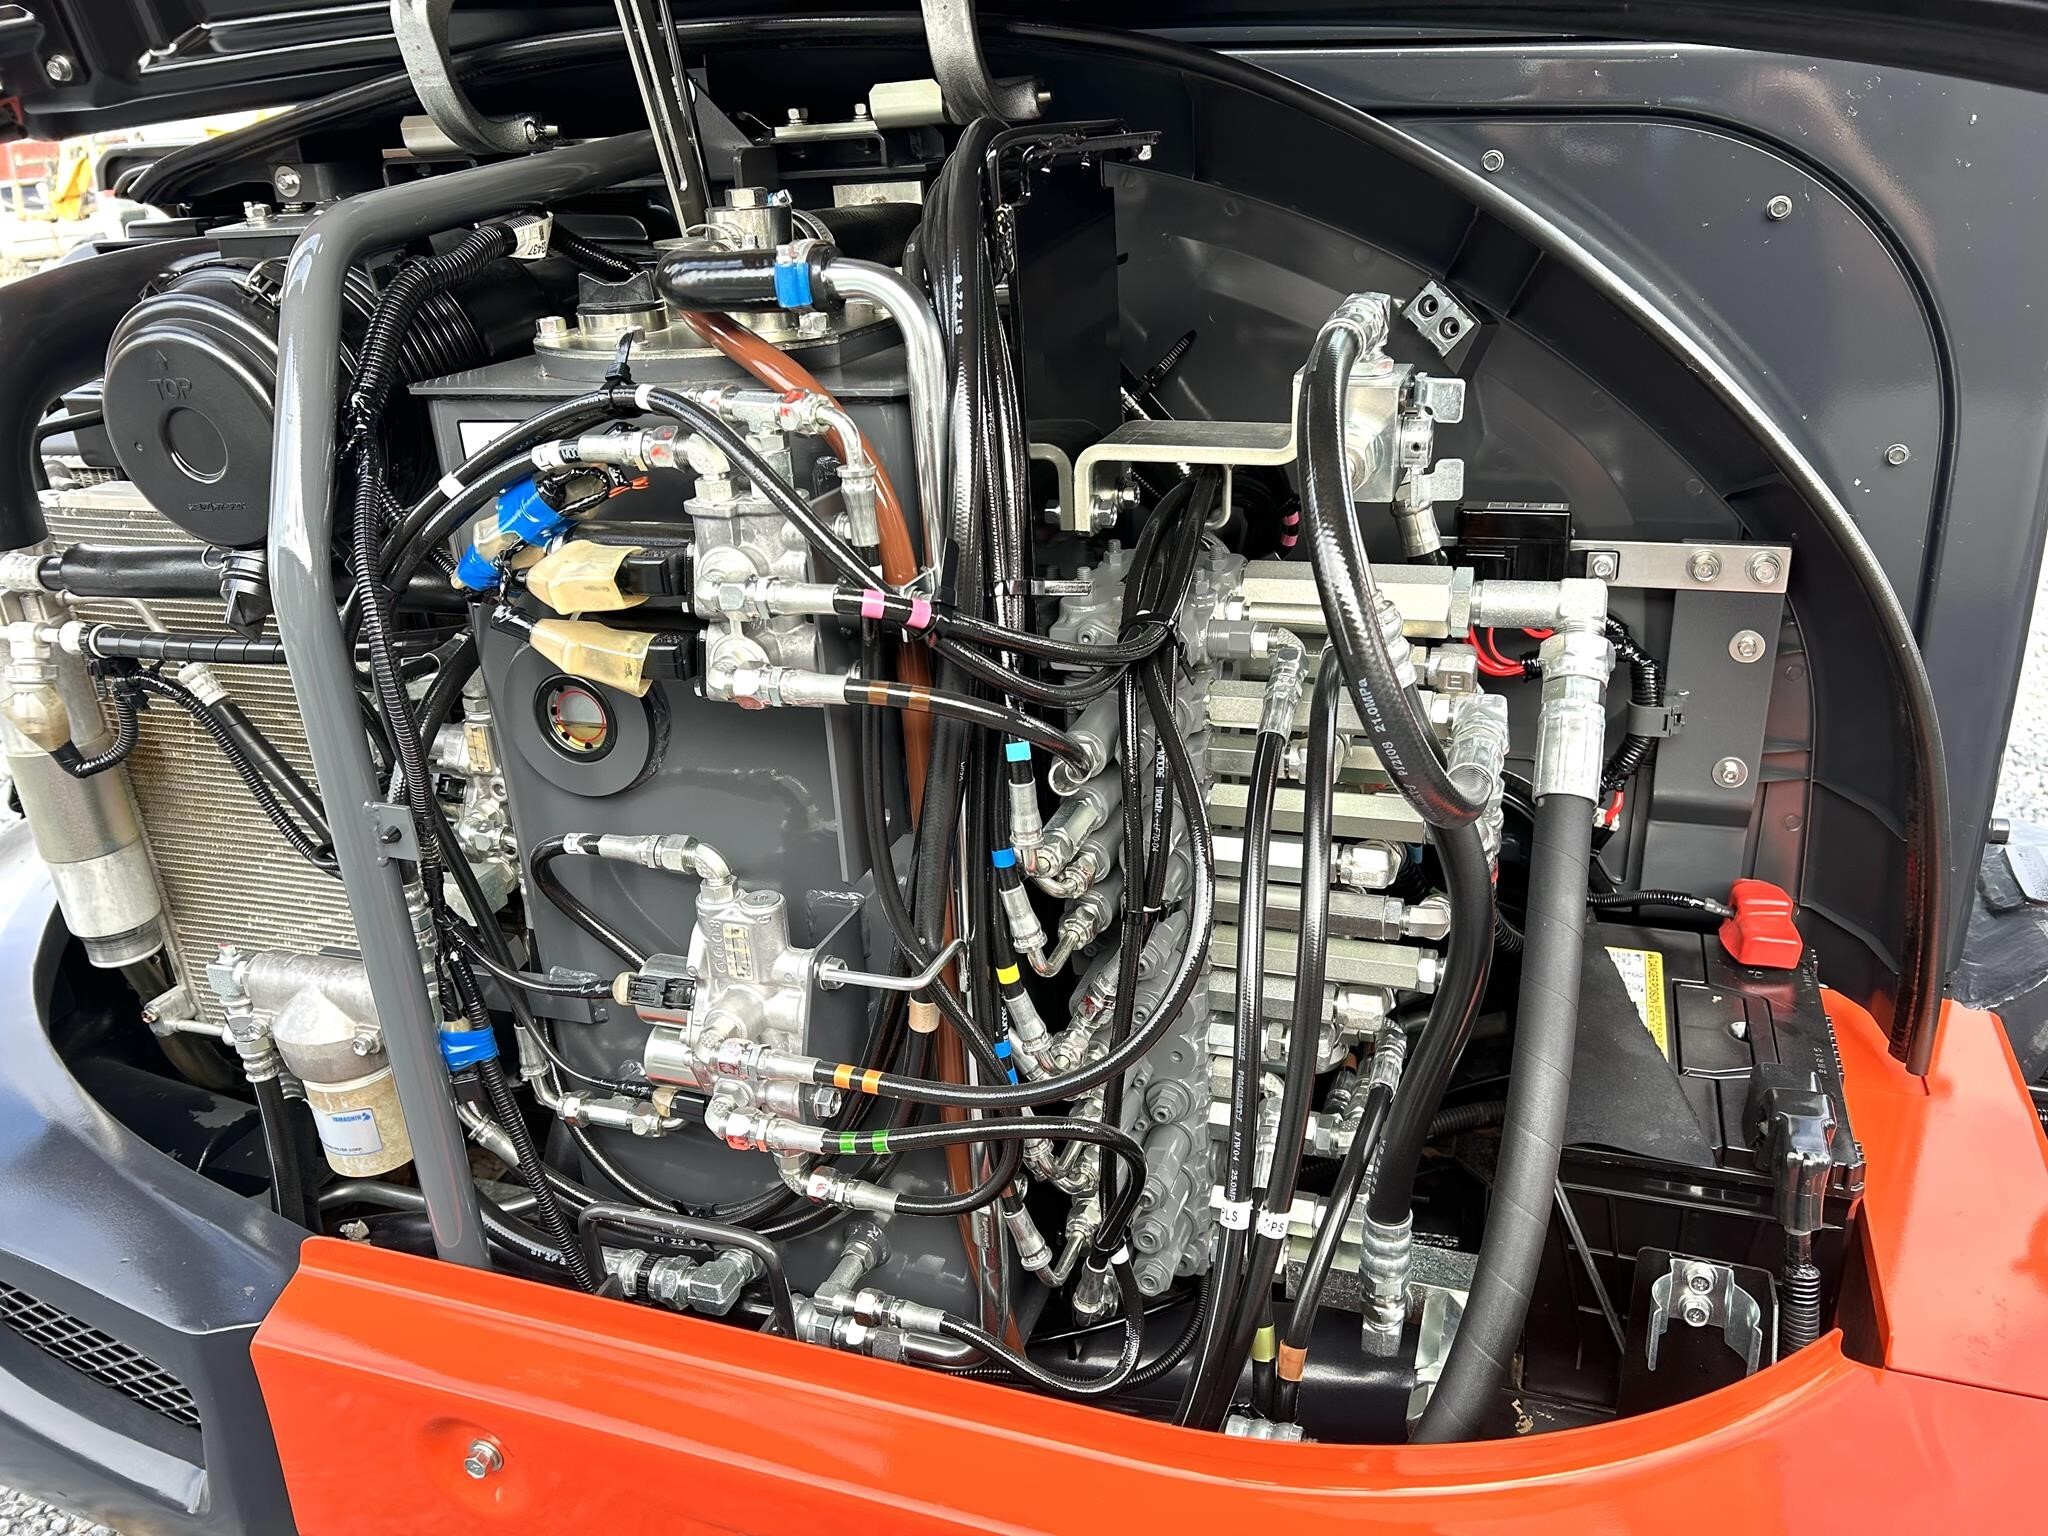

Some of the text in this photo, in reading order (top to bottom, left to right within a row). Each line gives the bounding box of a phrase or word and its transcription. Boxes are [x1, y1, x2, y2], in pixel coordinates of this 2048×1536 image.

[147, 377, 193, 400] TOP
[561, 448, 580, 460] MOO
[1229, 1168, 1239, 1201] 25.0MP
